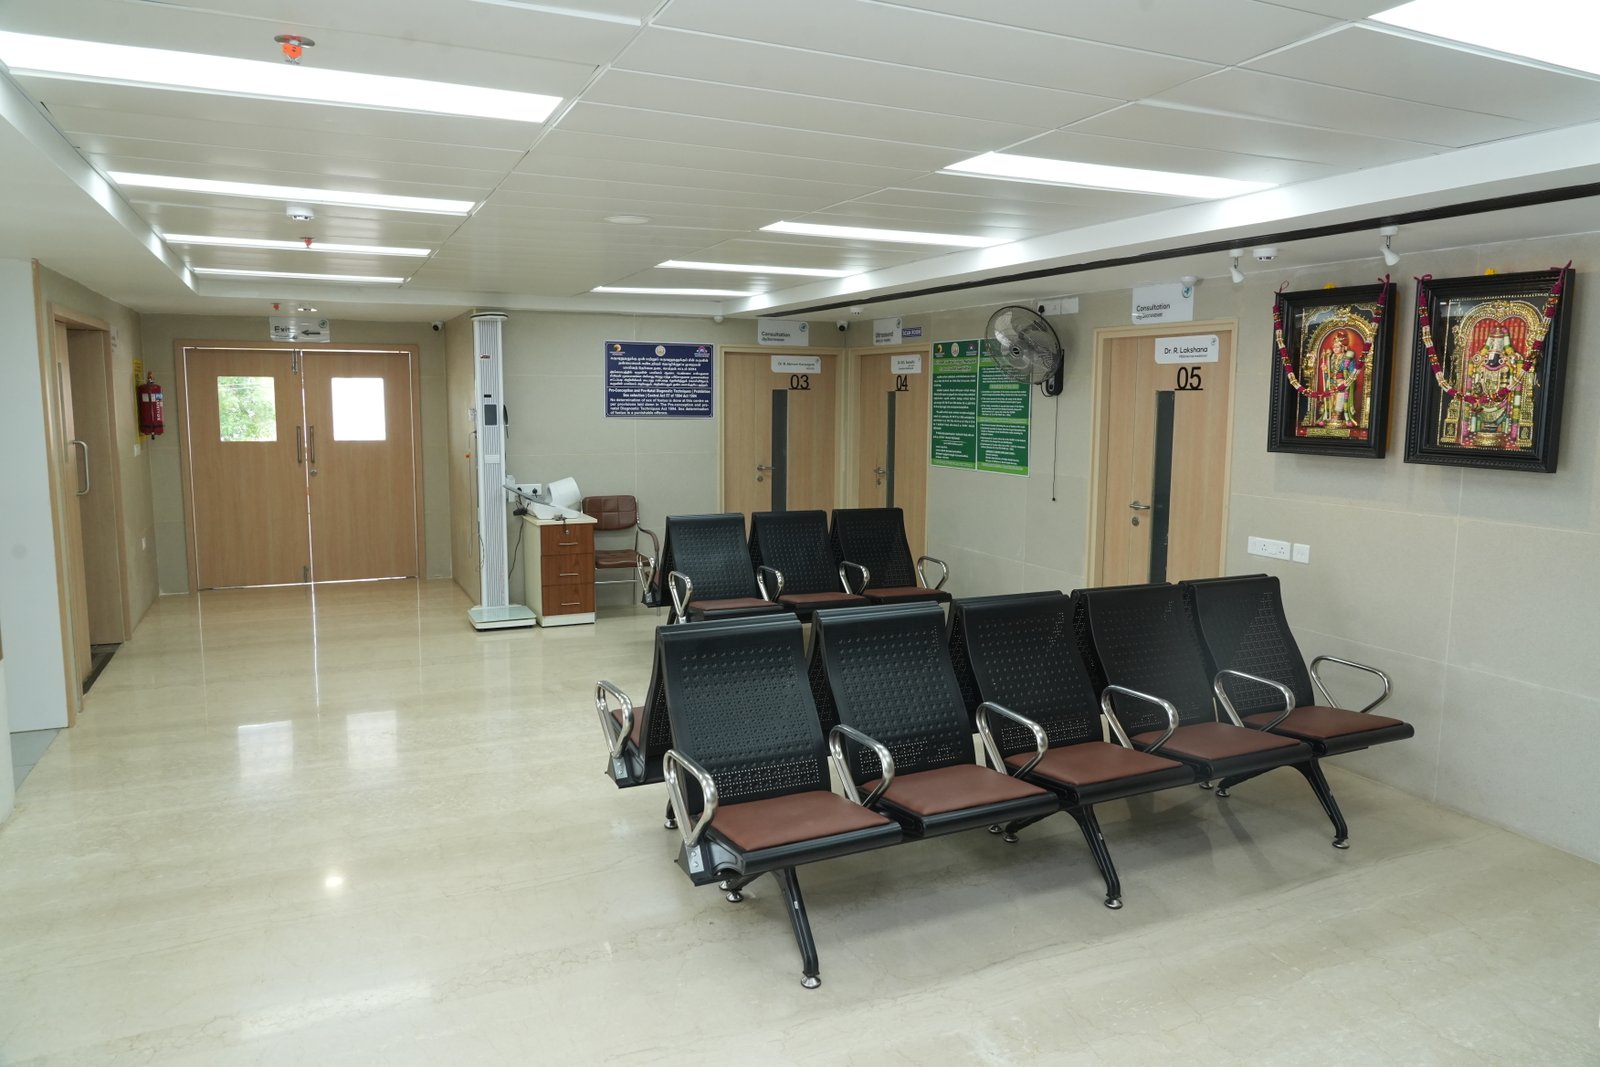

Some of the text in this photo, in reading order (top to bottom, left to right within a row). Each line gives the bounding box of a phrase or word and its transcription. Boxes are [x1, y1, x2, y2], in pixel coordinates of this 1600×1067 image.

[1136, 303, 1171, 312] Consultation
[1179, 346, 1208, 354] Lakshana
[790, 374, 810, 390] 03
[896, 374, 909, 391] 04
[1177, 366, 1202, 390] 05
